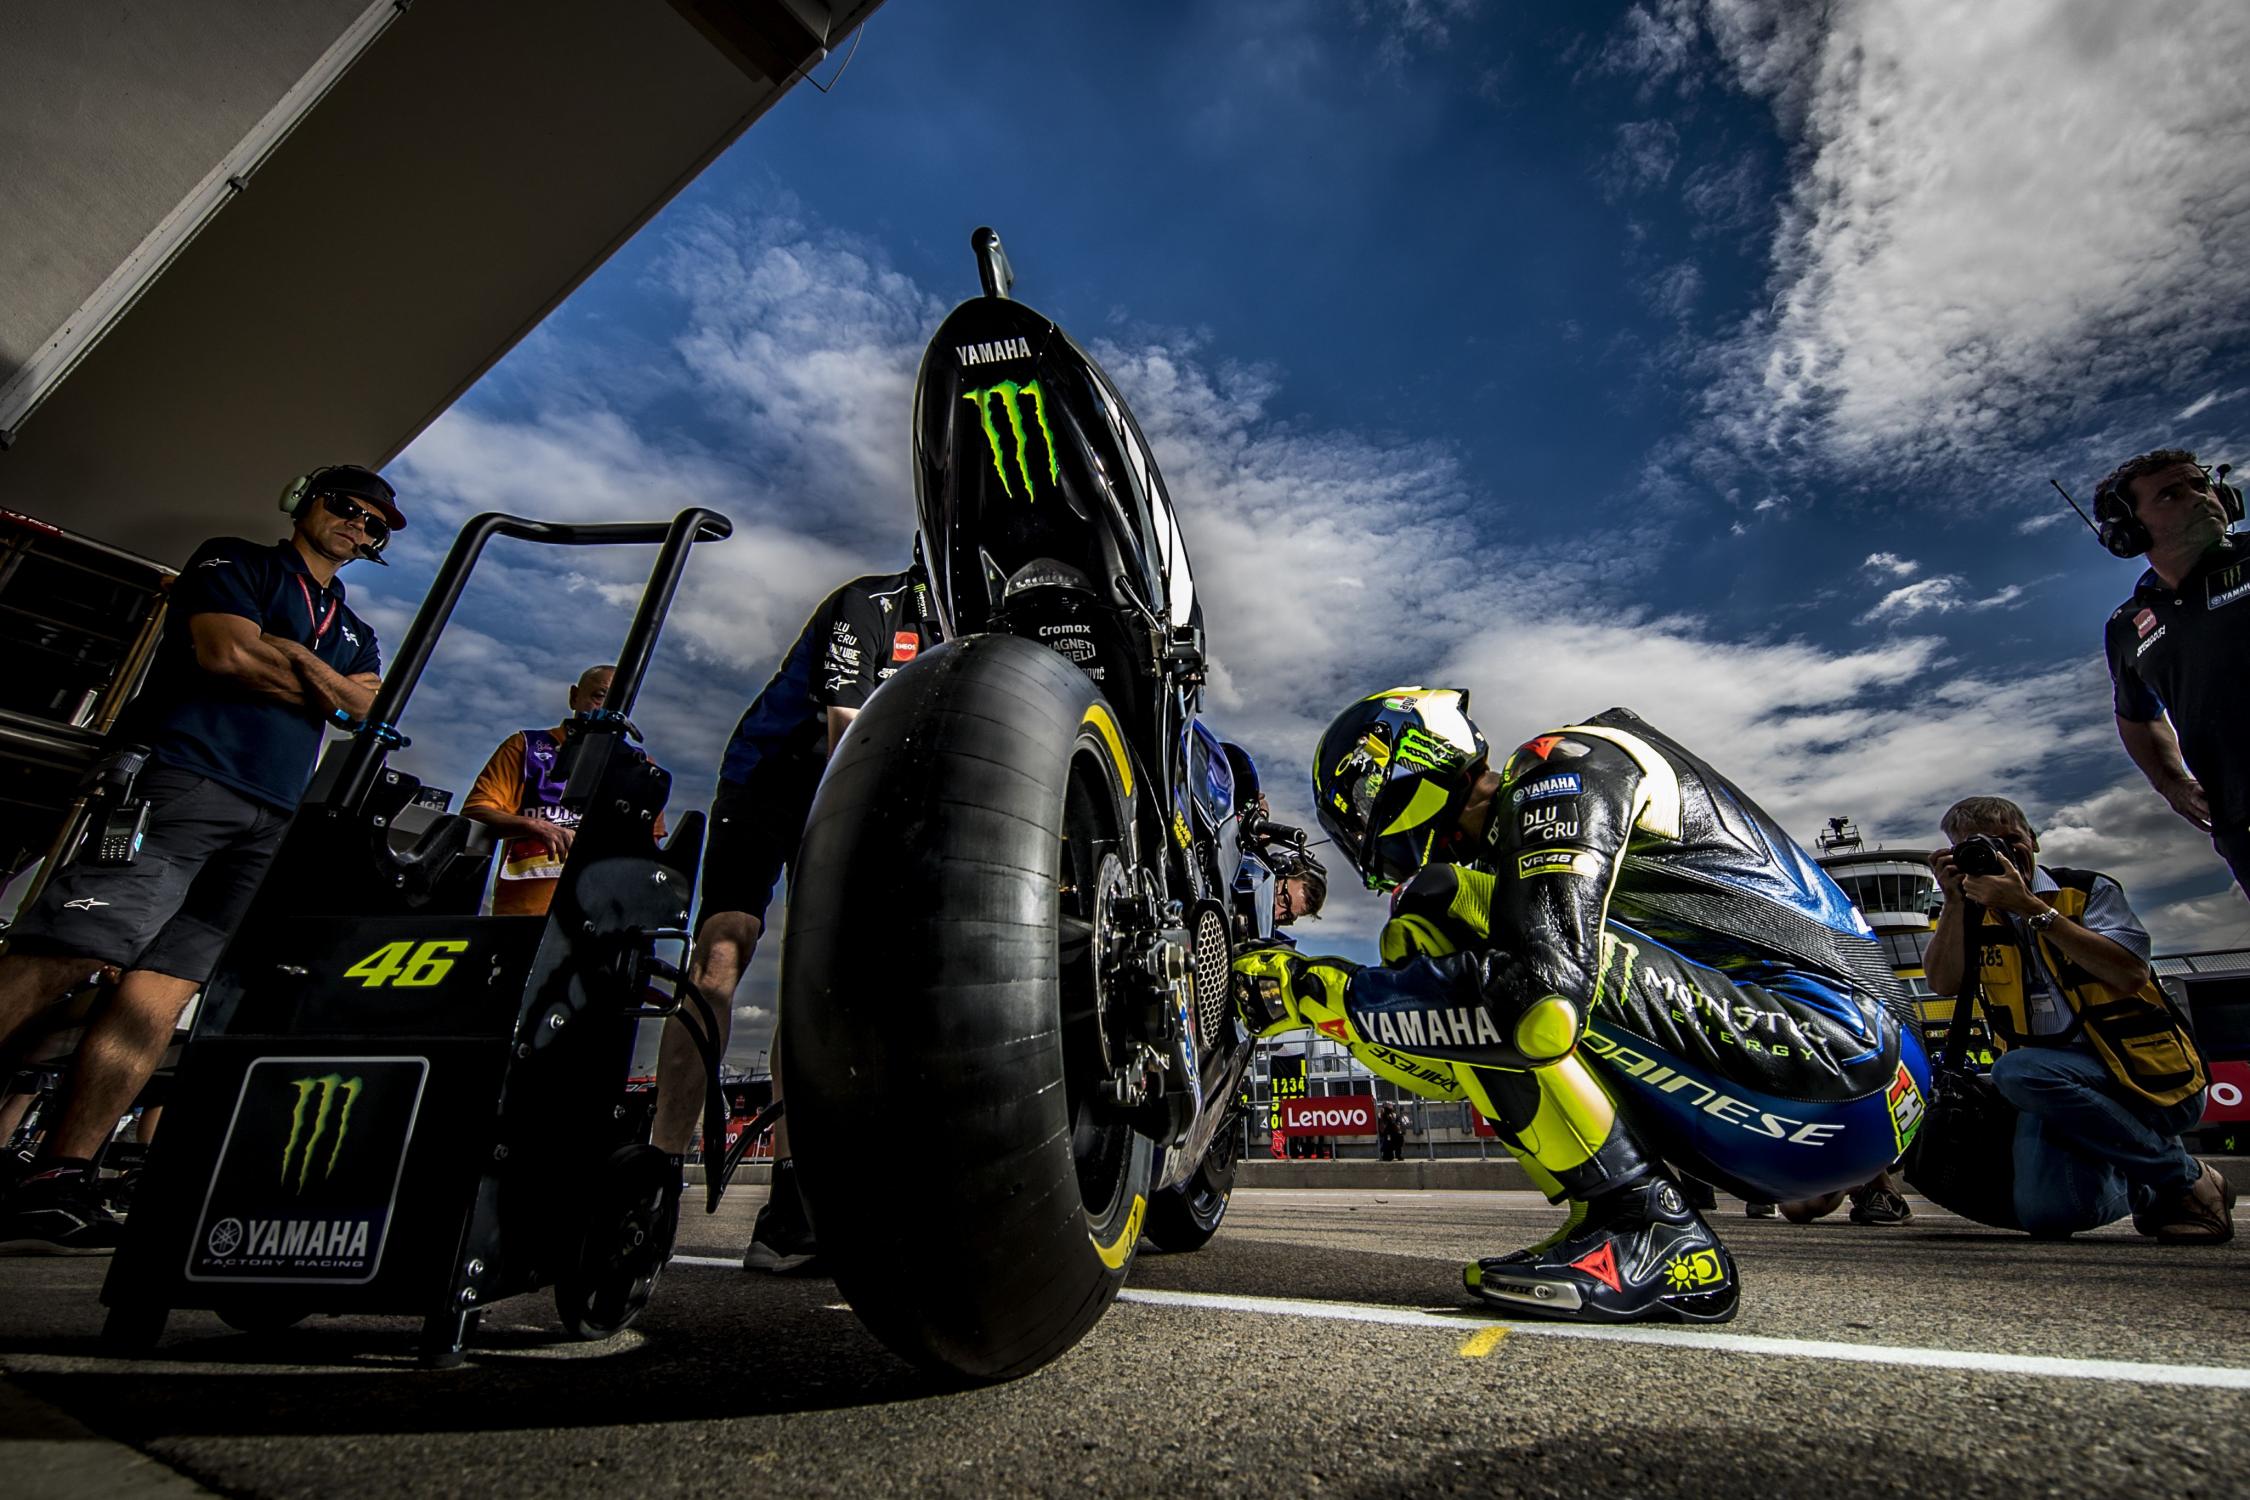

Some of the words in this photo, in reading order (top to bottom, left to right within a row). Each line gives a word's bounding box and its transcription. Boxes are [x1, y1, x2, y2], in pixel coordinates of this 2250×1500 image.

[956, 337, 1031, 366] YAMAHA
[1038, 624, 1091, 637] Cromax
[1524, 776, 1577, 795] YAMAHA
[343, 940, 470, 987] 46
[1357, 1006, 1502, 1047] YAMAHA
[1287, 1107, 1368, 1128] Lenovo
[246, 1220, 369, 1257] YAMAHA
[202, 1258, 285, 1268] FACTORY
[294, 1259, 364, 1268] RACING
